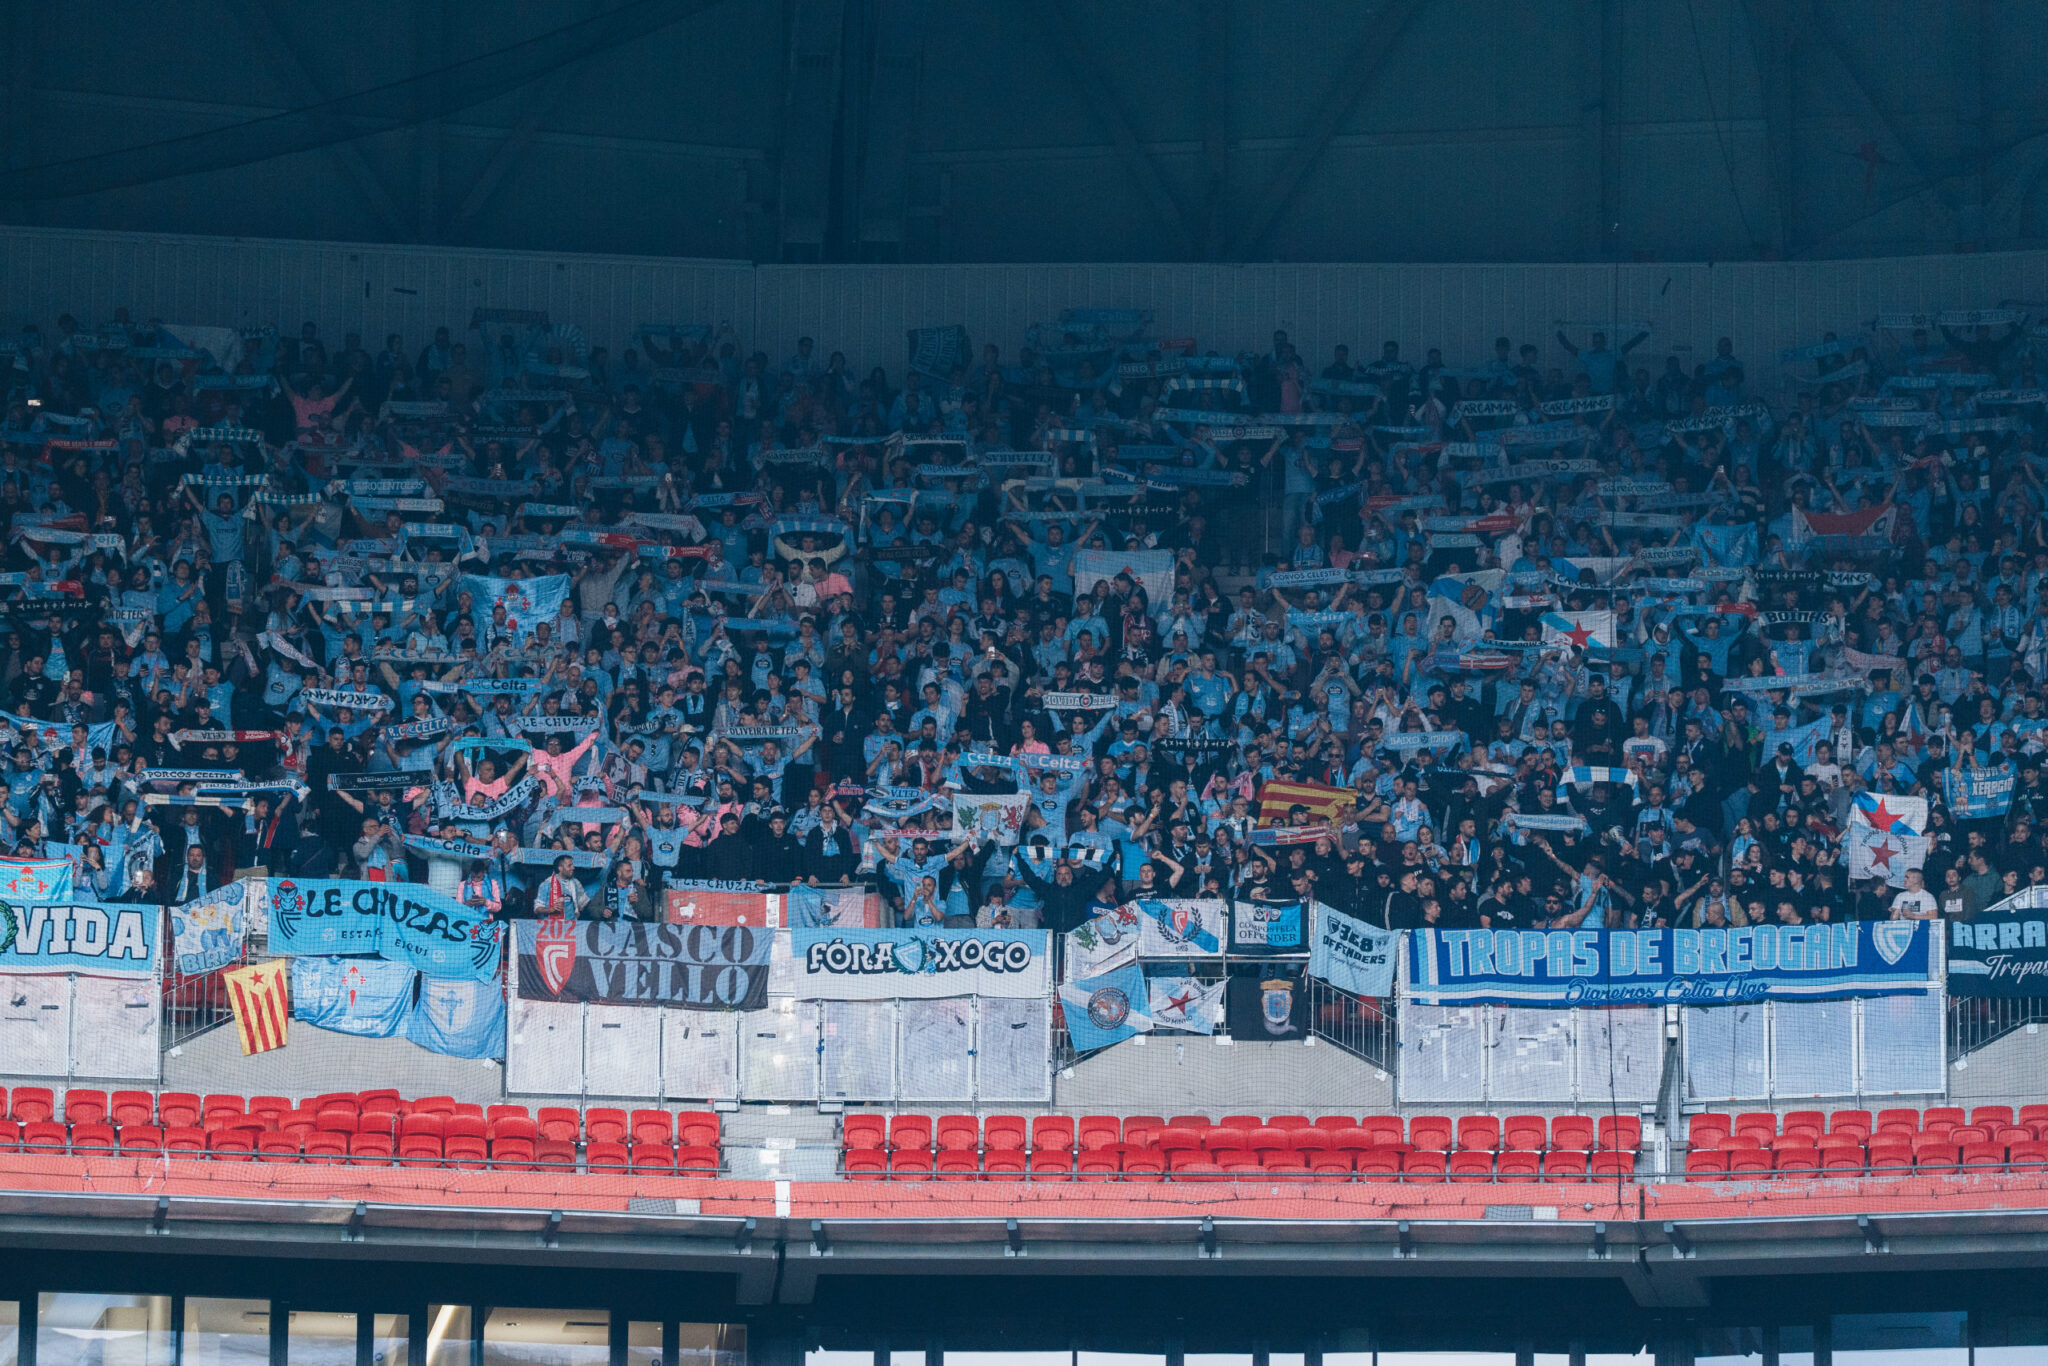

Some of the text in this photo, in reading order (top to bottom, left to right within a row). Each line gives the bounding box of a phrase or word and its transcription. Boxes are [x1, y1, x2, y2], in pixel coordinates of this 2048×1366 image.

[492, 679, 527, 691] Celta
[415, 716, 449, 734] CELTA
[729, 725, 799, 736] OLIVEIRA DE TEIS
[967, 752, 1012, 766] CELTA
[1039, 757, 1080, 769] Celta
[147, 770, 192, 779] PORCOS
[443, 840, 481, 856] Celta
[11, 905, 149, 960] VIDA
[536, 919, 577, 940] 202
[1239, 920, 1297, 933] COMPOSTELA
[585, 920, 755, 964] CASCO
[1239, 931, 1297, 943] OFFENDER
[807, 937, 1031, 974] FÓRA XOGO
[1322, 934, 1386, 965] OFFENDERS
[1441, 928, 1600, 977] TROPAS
[1609, 928, 1662, 976] DE
[588, 957, 750, 1006] VELLO
[1663, 975, 1716, 1002] Celta
